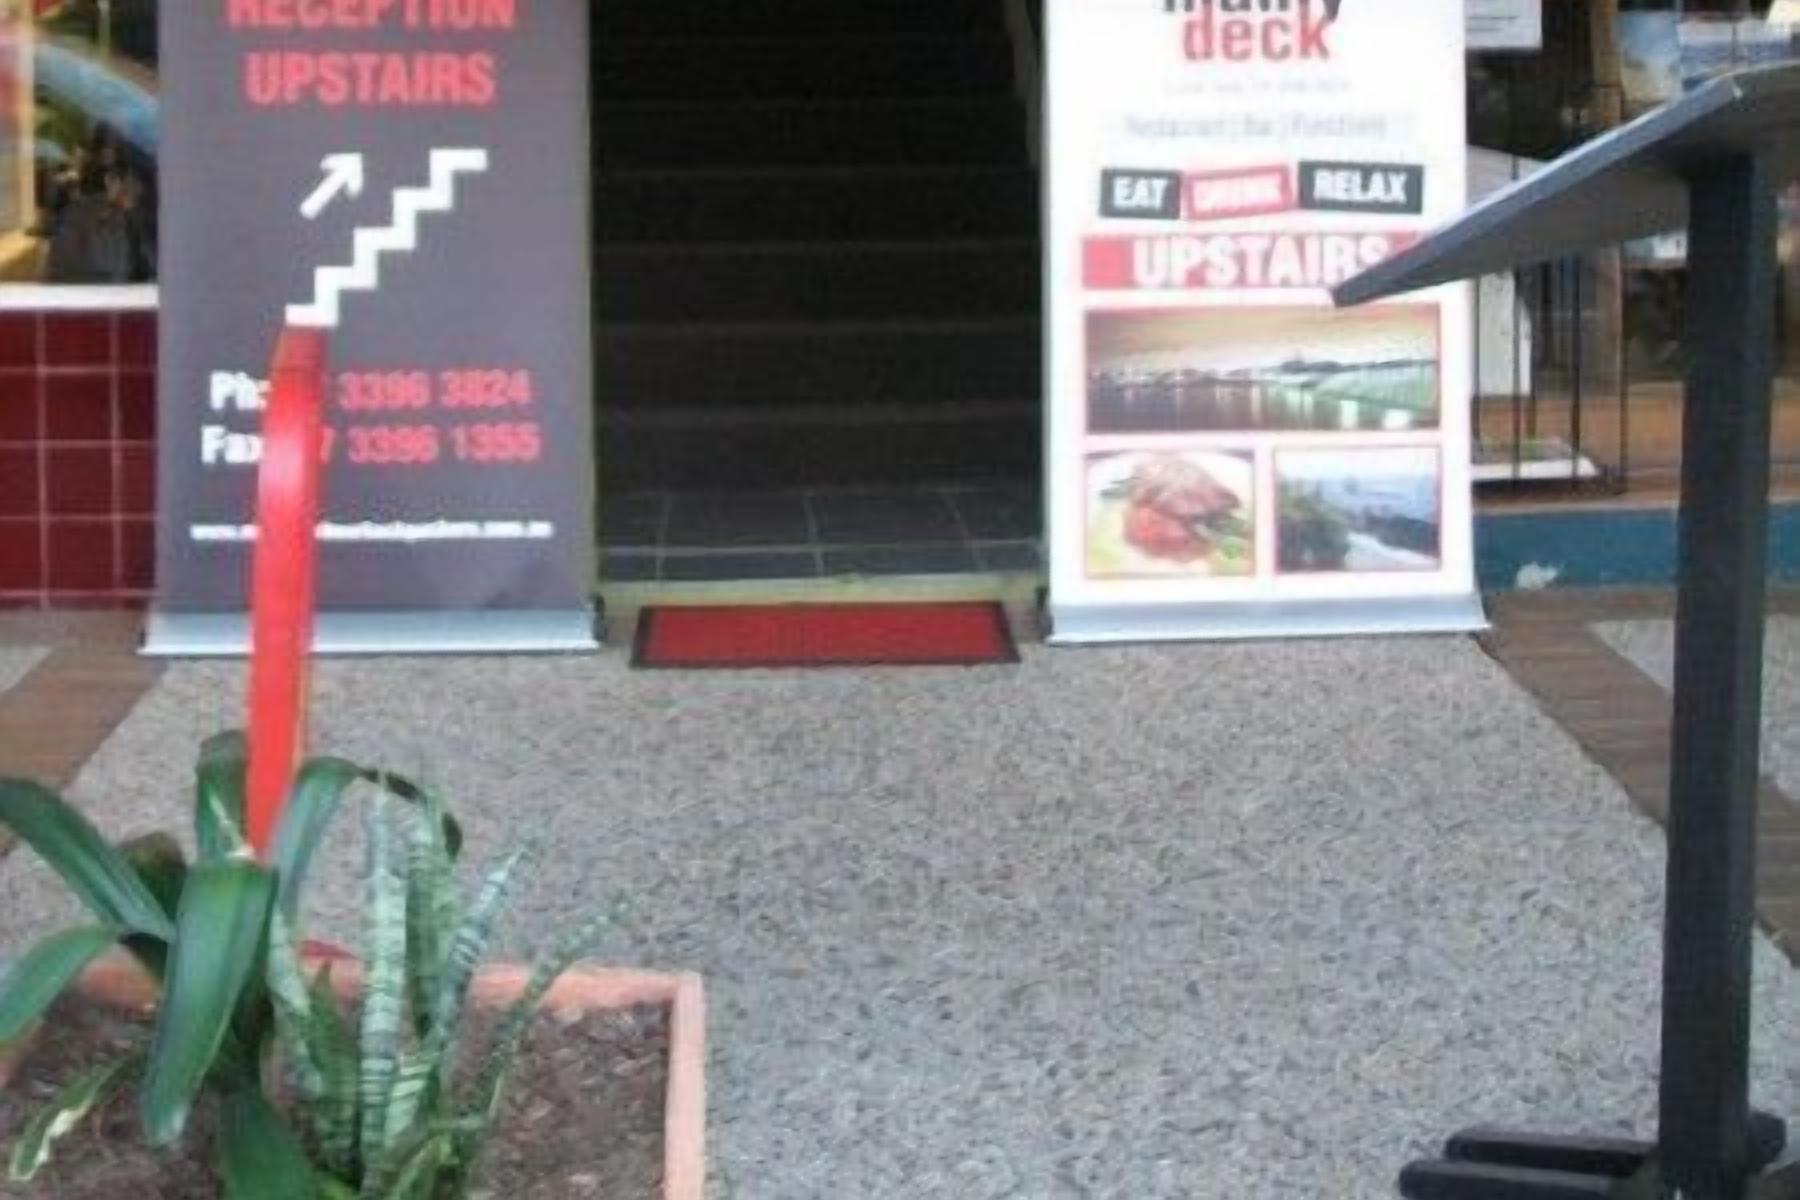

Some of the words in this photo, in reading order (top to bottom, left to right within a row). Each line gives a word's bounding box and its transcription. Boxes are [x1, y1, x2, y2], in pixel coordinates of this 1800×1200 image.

[1182, 1, 1331, 62] deck
[245, 50, 497, 105] UPSTAIRS
[1111, 175, 1168, 211] EAT
[1312, 168, 1408, 205] RELAX
[1132, 234, 1390, 286] UPSTAIRS
